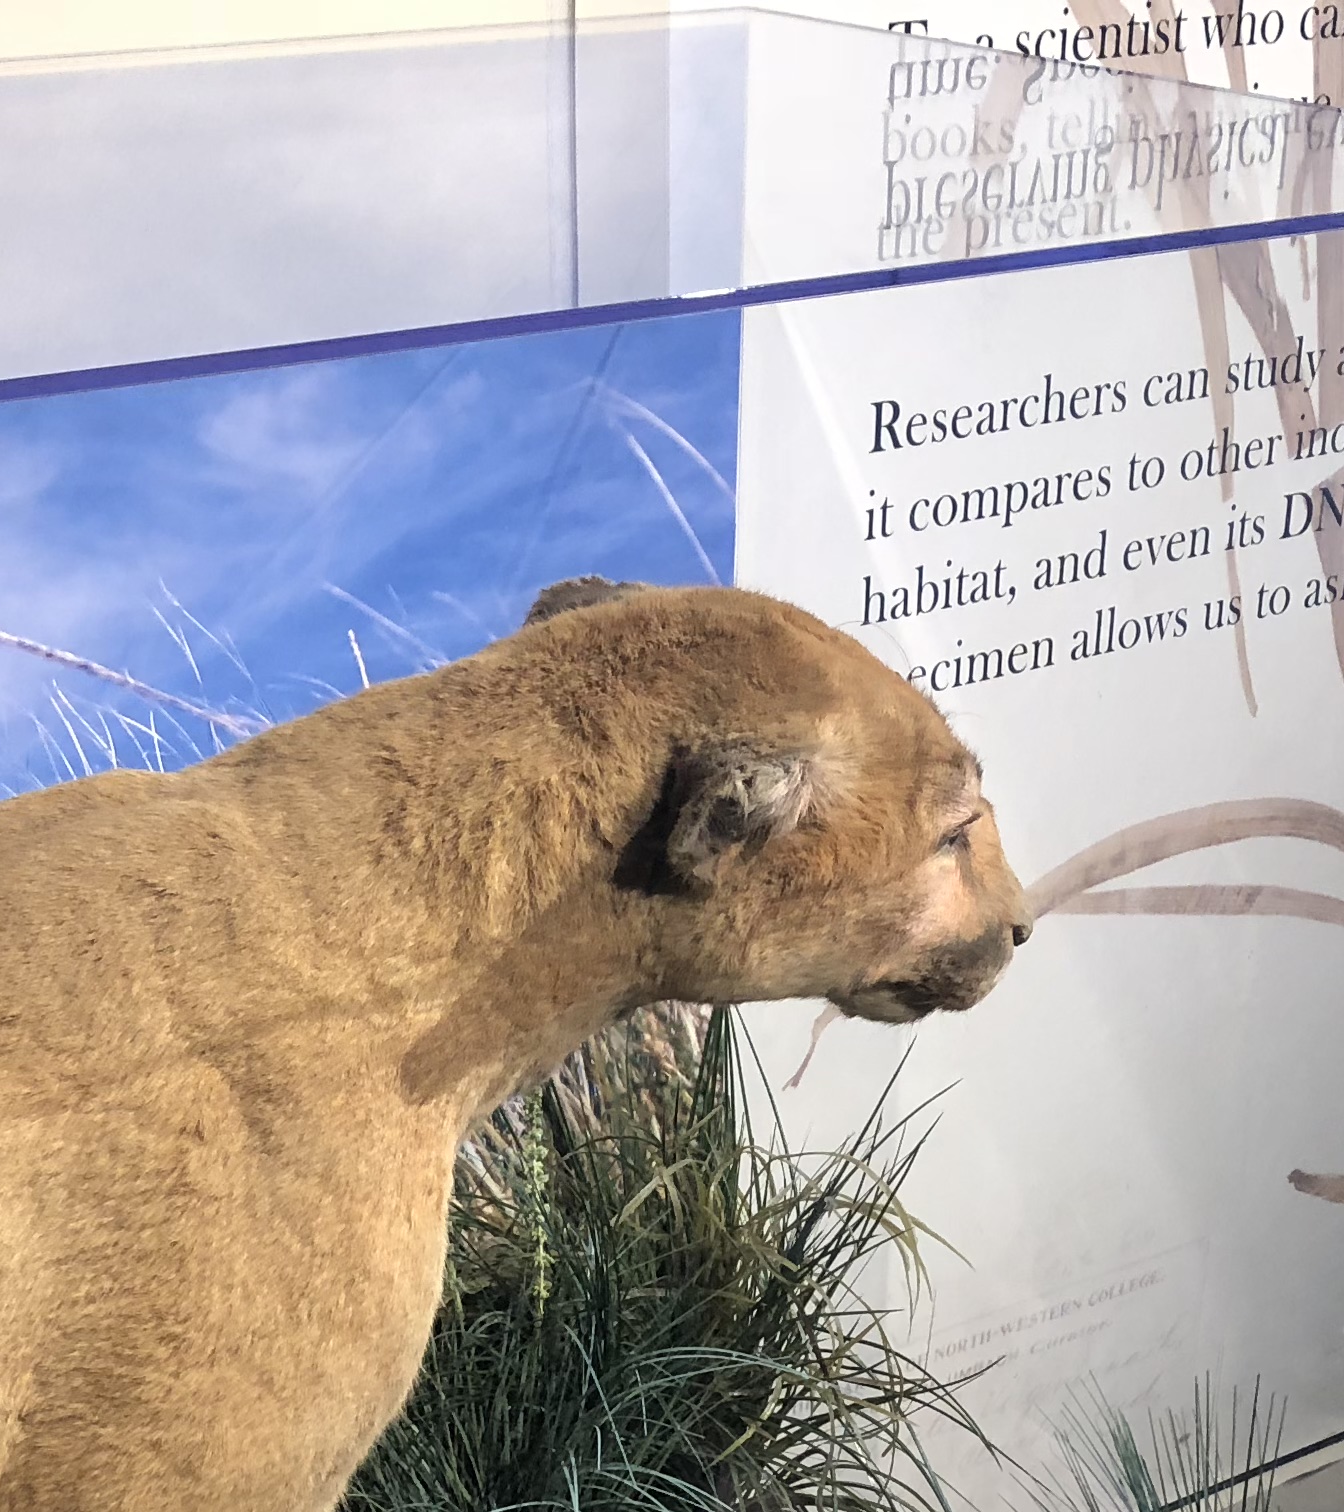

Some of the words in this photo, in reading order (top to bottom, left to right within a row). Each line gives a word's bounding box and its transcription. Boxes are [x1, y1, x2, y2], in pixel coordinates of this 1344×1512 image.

[1015, 1, 1187, 61] scientist
[1202, 1, 1285, 49] who
[869, 374, 1127, 454] Researchers
[1144, 367, 1209, 407] can
[1225, 336, 1325, 394] study
[864, 490, 894, 541] it
[909, 465, 1111, 527] compares
[1129, 453, 1164, 492] to
[1181, 427, 1282, 481] other
[860, 558, 1016, 626] habitat,
[1033, 530, 1106, 590] and
[1123, 527, 1210, 571] even
[1225, 504, 1265, 550] its
[906, 636, 1054, 692] ecimen
[1070, 606, 1188, 661] allows
[1204, 595, 1242, 631] us
[1257, 582, 1290, 620] to
